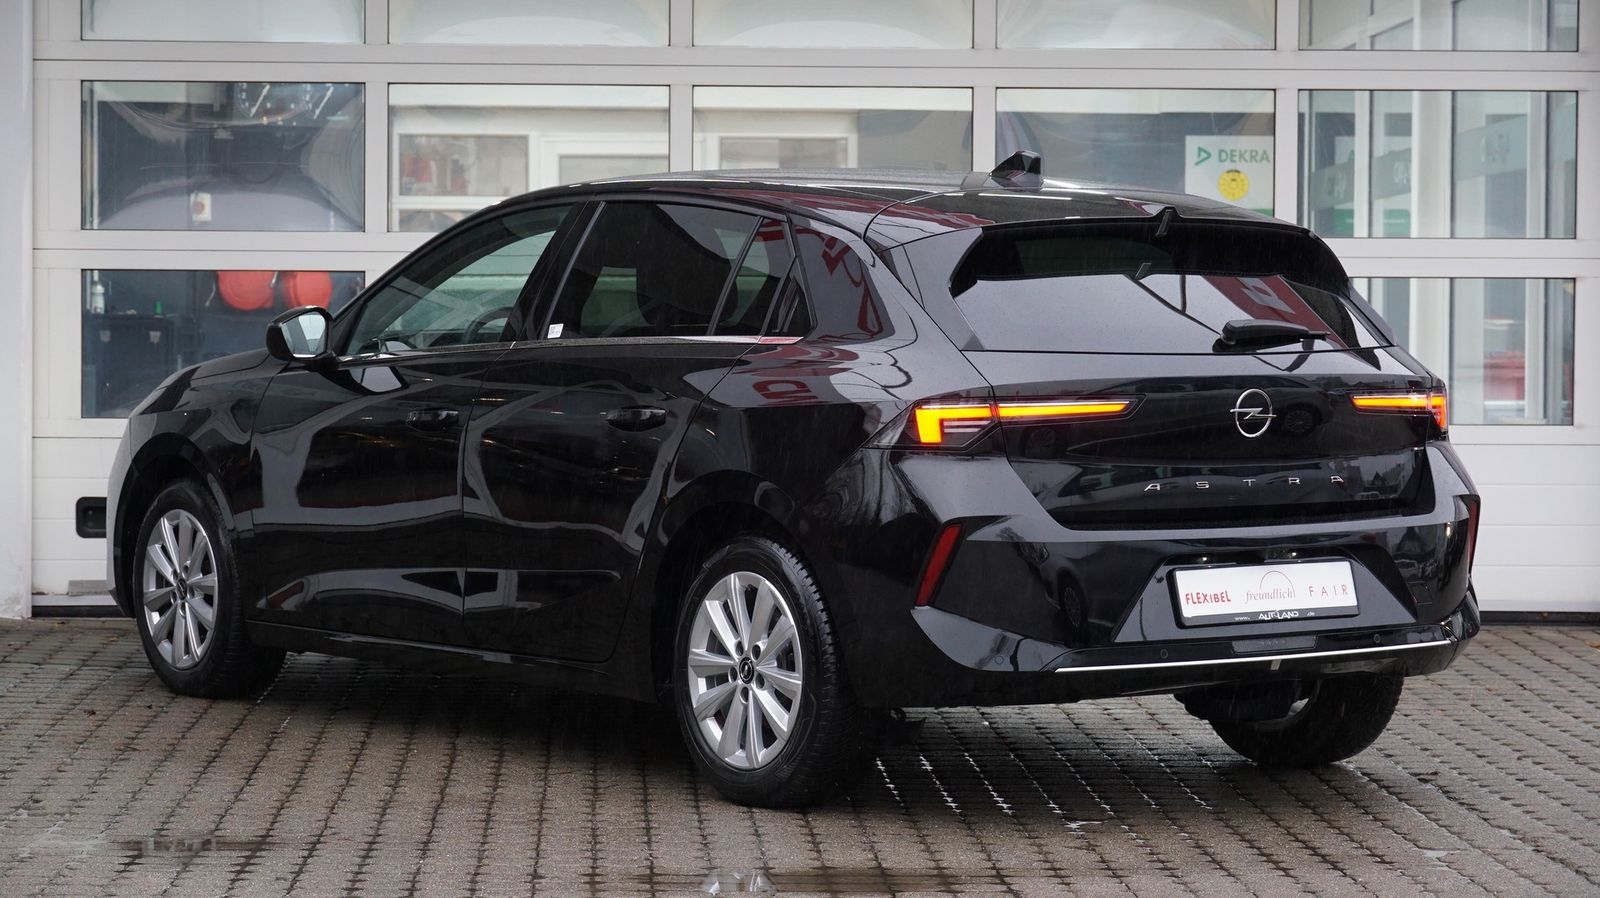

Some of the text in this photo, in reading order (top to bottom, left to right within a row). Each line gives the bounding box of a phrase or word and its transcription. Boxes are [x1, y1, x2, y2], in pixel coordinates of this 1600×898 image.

[1218, 149, 1270, 163] DEKRA
[1144, 475, 1344, 492] ASTRA
[1185, 584, 1349, 605] FLEXIBEL freundlich FAIR
[1258, 609, 1299, 621] AUTOLAND
